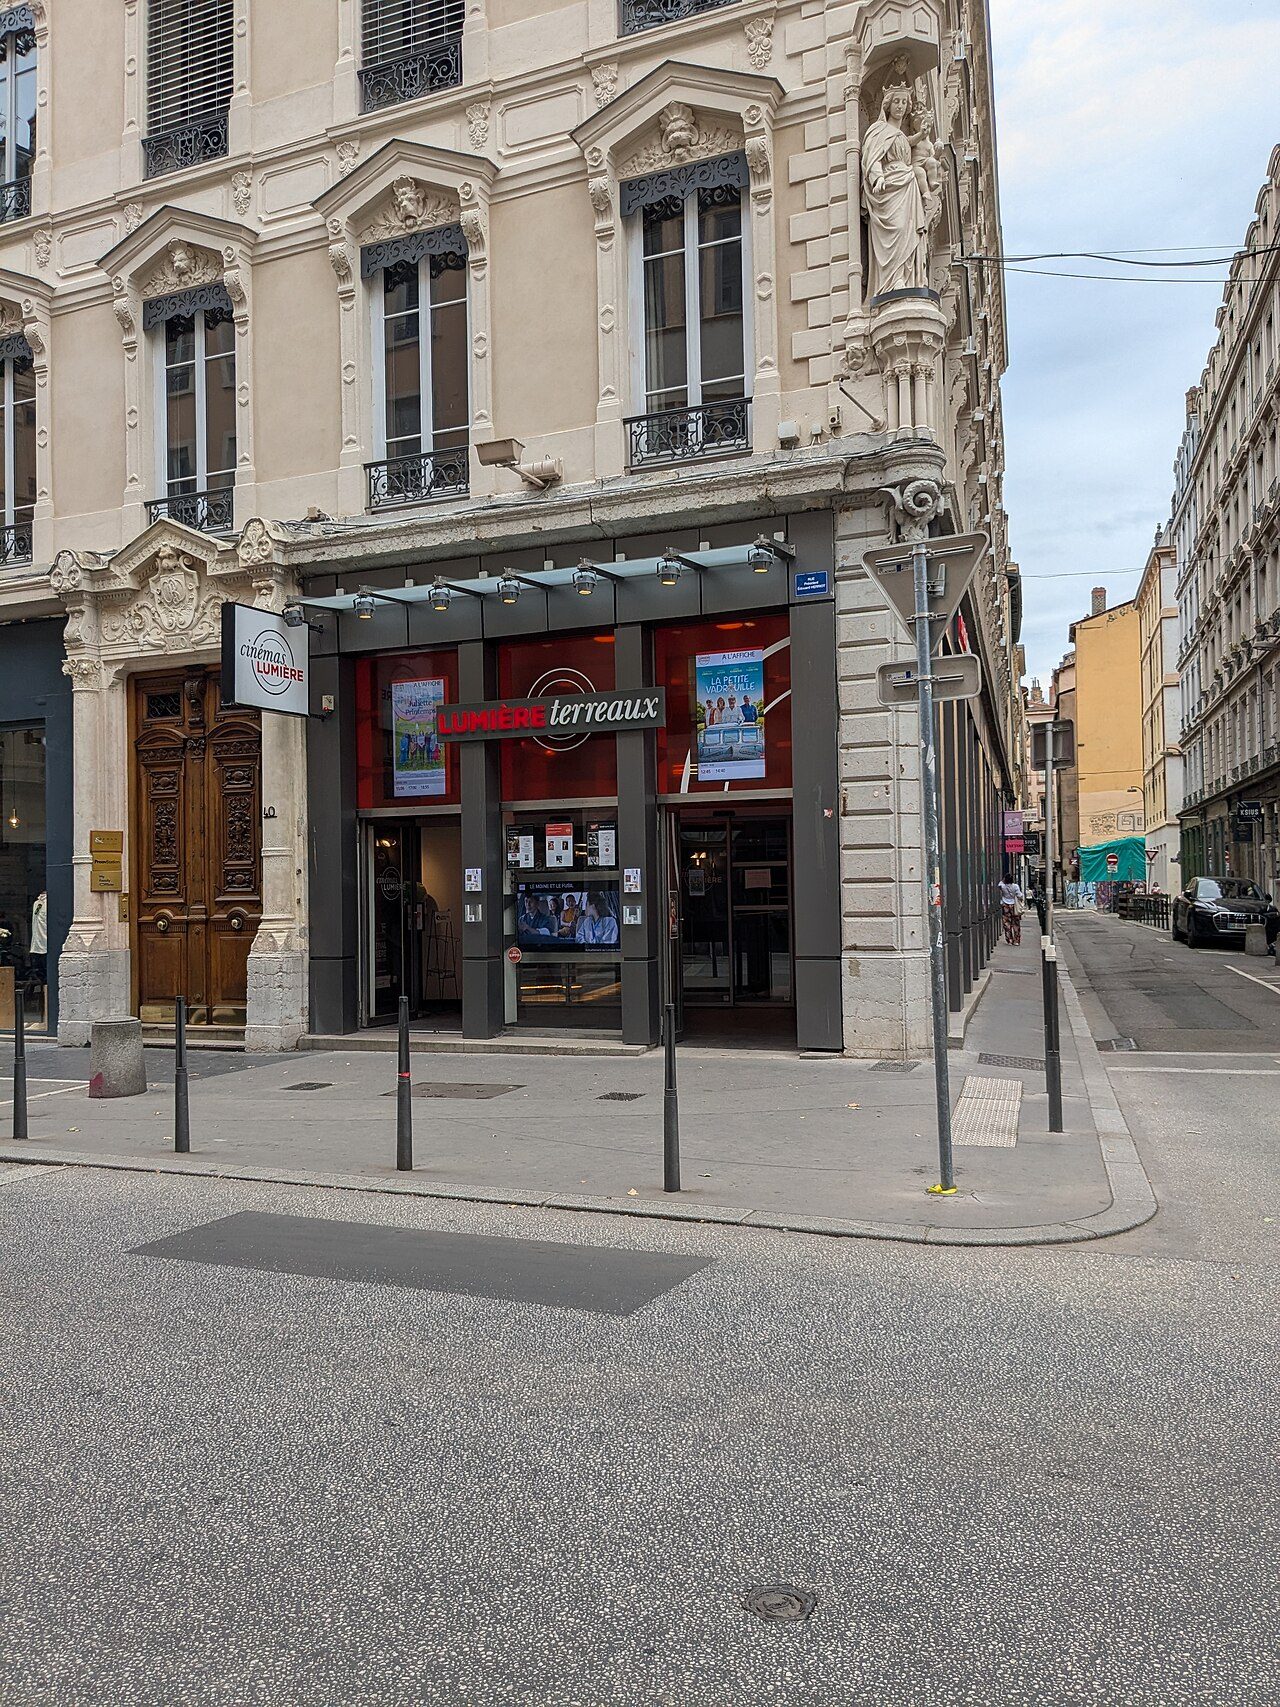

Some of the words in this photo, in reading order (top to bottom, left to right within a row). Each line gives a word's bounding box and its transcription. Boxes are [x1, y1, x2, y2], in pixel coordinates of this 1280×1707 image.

[240, 639, 287, 665] cinémas
[256, 661, 304, 682] LUMIÈRE
[711, 677, 722, 685] LA
[723, 674, 749, 684] PETITE
[438, 703, 547, 736] LUMIÈRE
[549, 696, 659, 726] terreaux
[264, 806, 277, 818] 40
[1240, 808, 1259, 816] KSIUS
